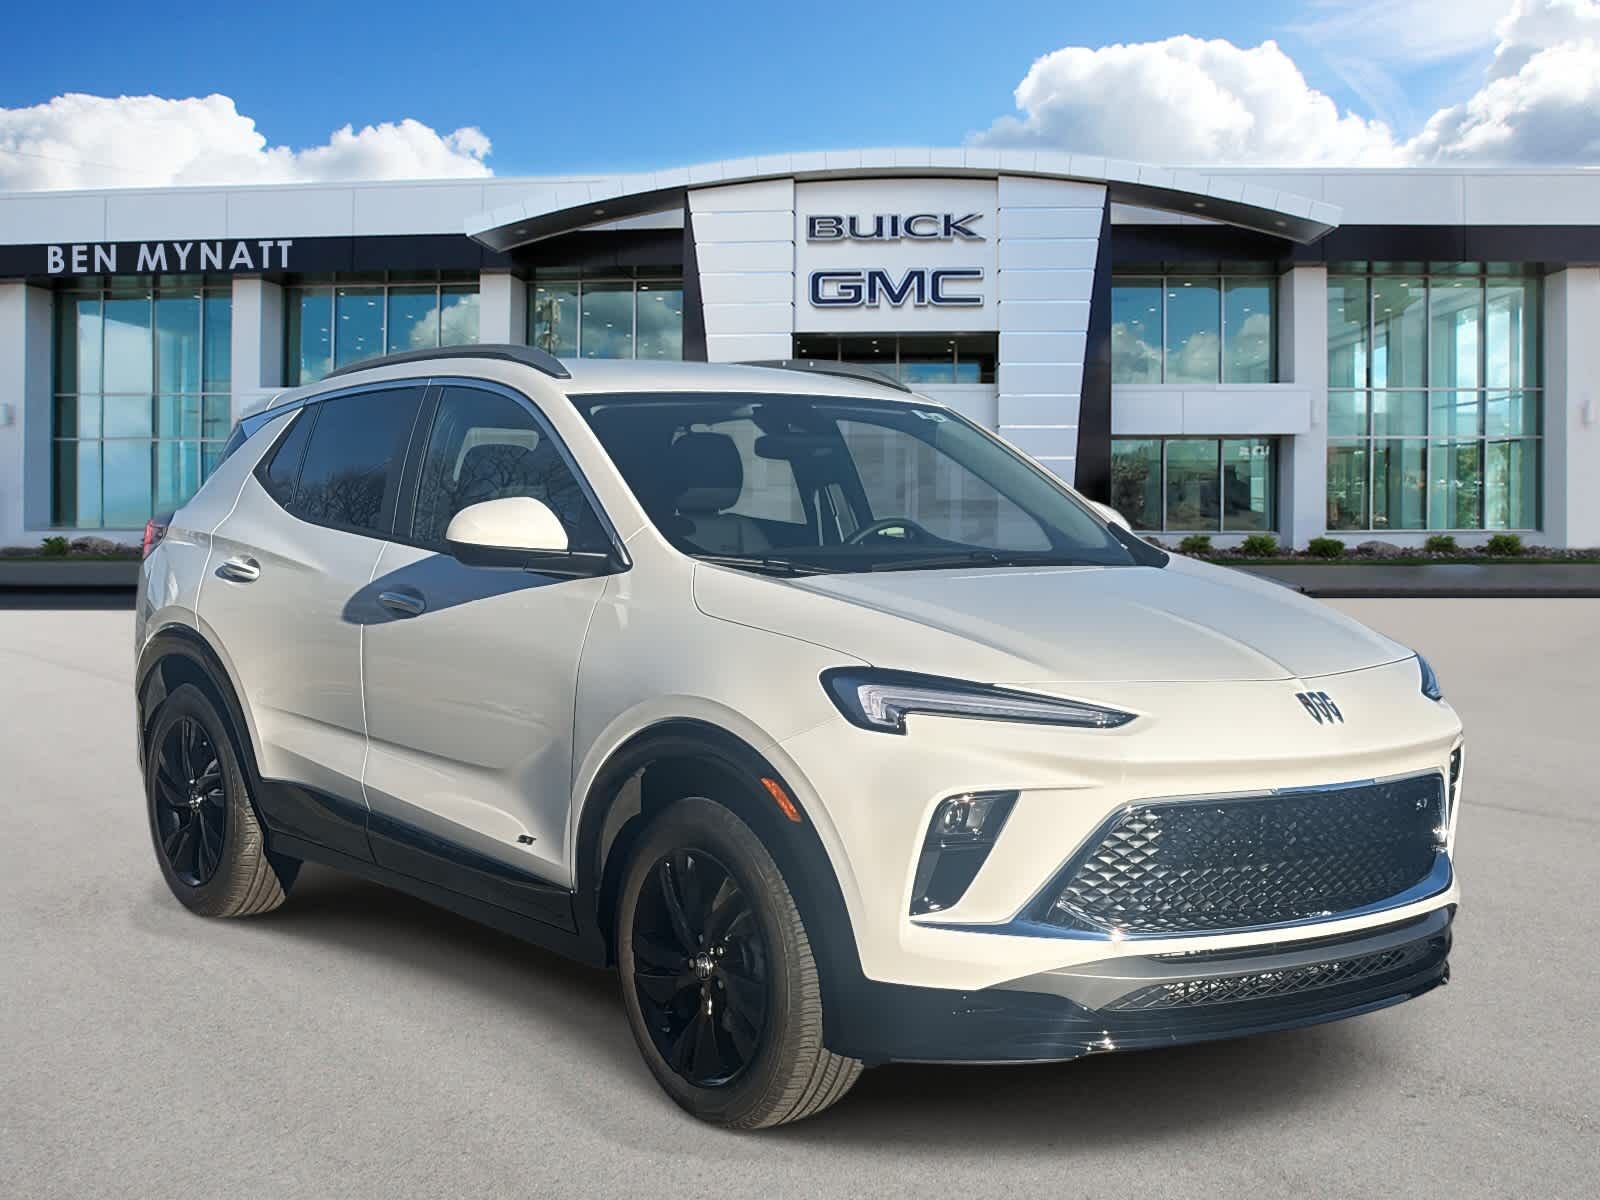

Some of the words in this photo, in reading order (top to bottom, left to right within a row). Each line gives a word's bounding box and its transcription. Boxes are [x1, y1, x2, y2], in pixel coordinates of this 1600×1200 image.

[807, 213, 986, 242] BUICK
[47, 245, 117, 274] BEN
[136, 240, 293, 272] MYNATT
[809, 268, 984, 308] GMC
